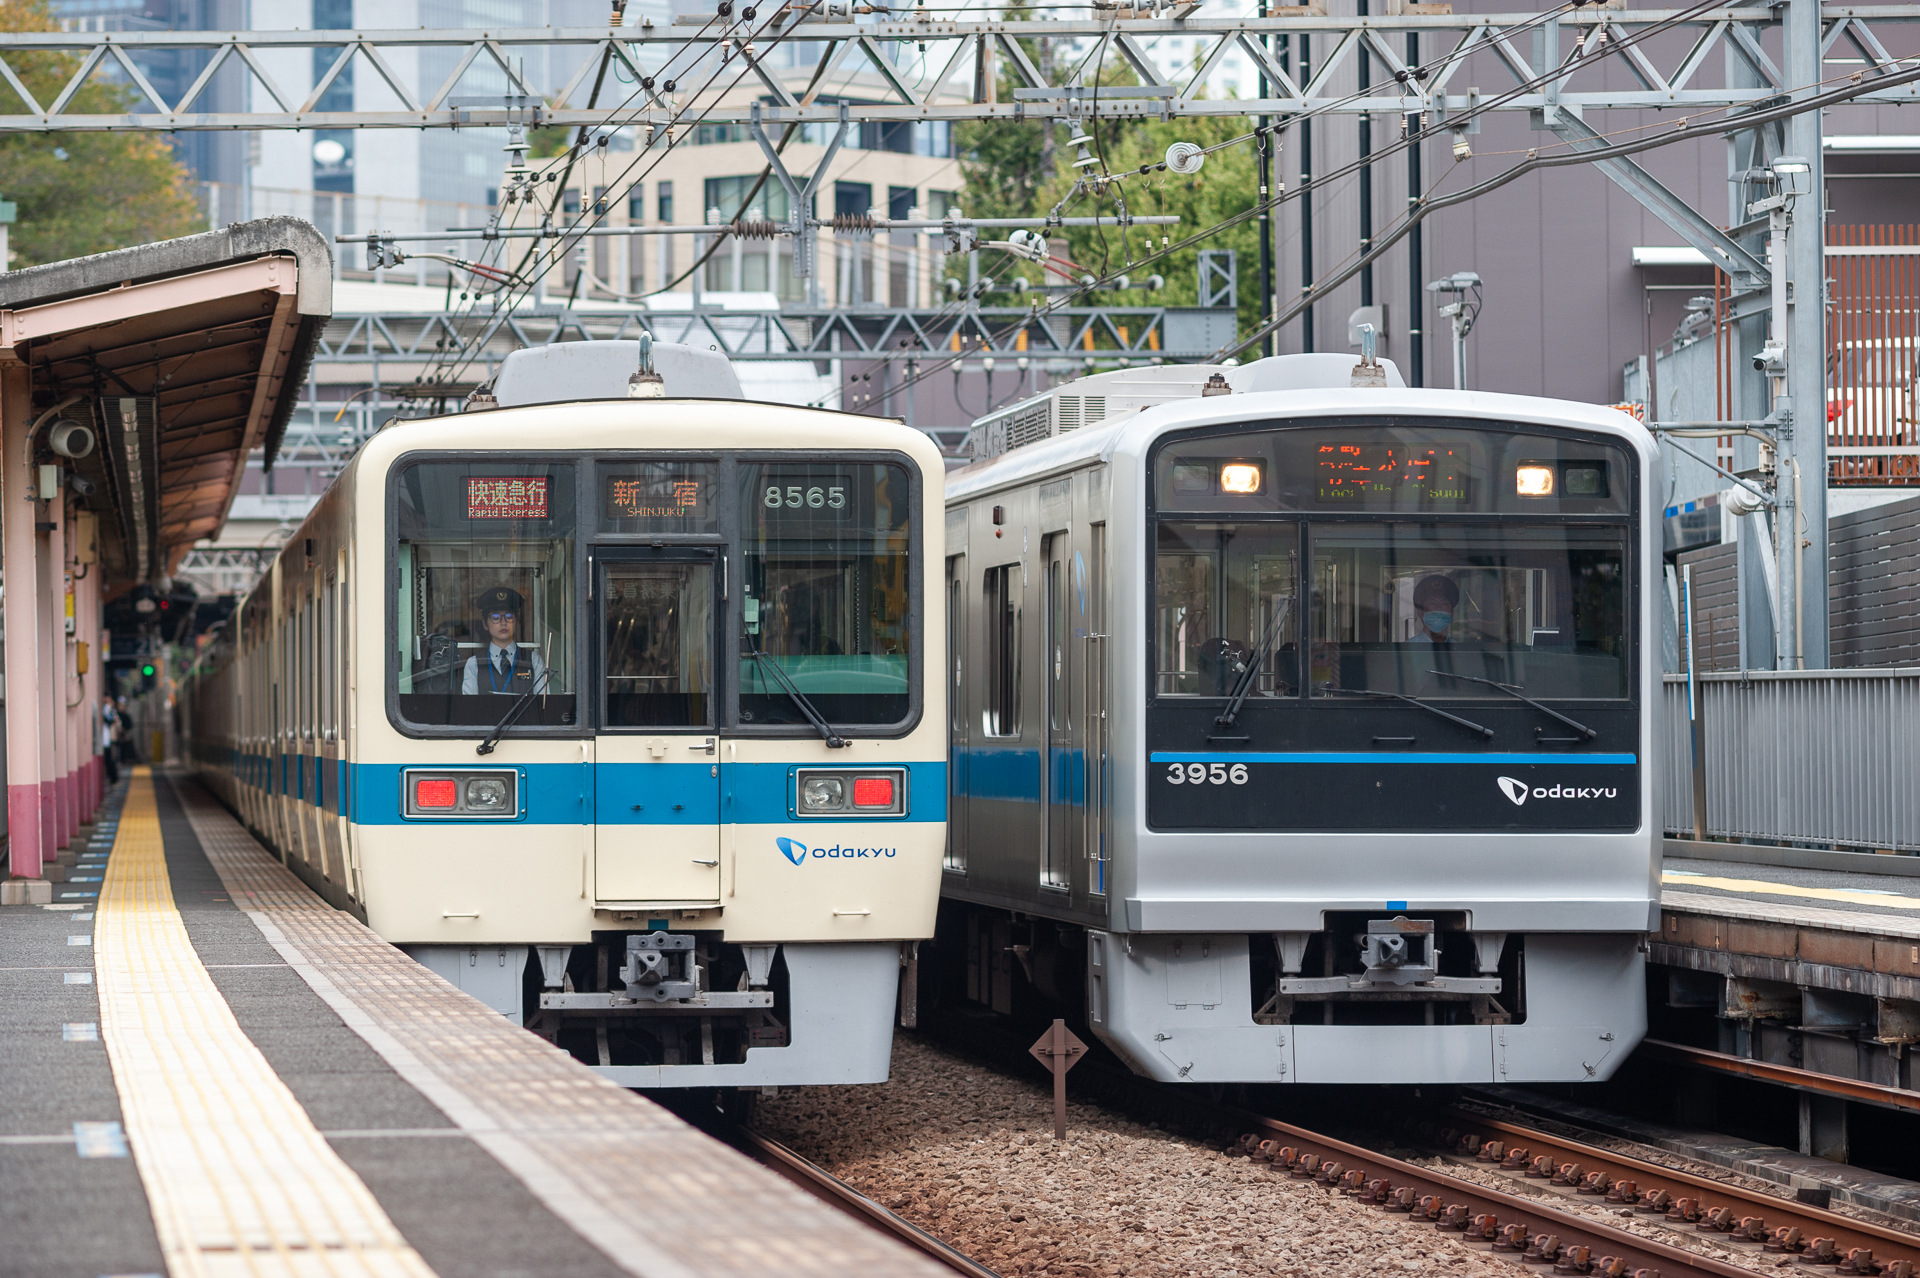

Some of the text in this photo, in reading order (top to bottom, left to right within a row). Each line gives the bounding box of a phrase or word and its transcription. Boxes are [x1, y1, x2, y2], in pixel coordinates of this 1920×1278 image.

[468, 479, 547, 506] 快速急行
[613, 480, 699, 507] 新宿
[764, 486, 846, 509] 8565
[468, 507, 547, 518] Rapid Express
[627, 506, 685, 517] SHINJUKU
[1166, 762, 1249, 785] 3956
[1532, 783, 1617, 799] odakyu
[811, 844, 896, 859] odakyu
